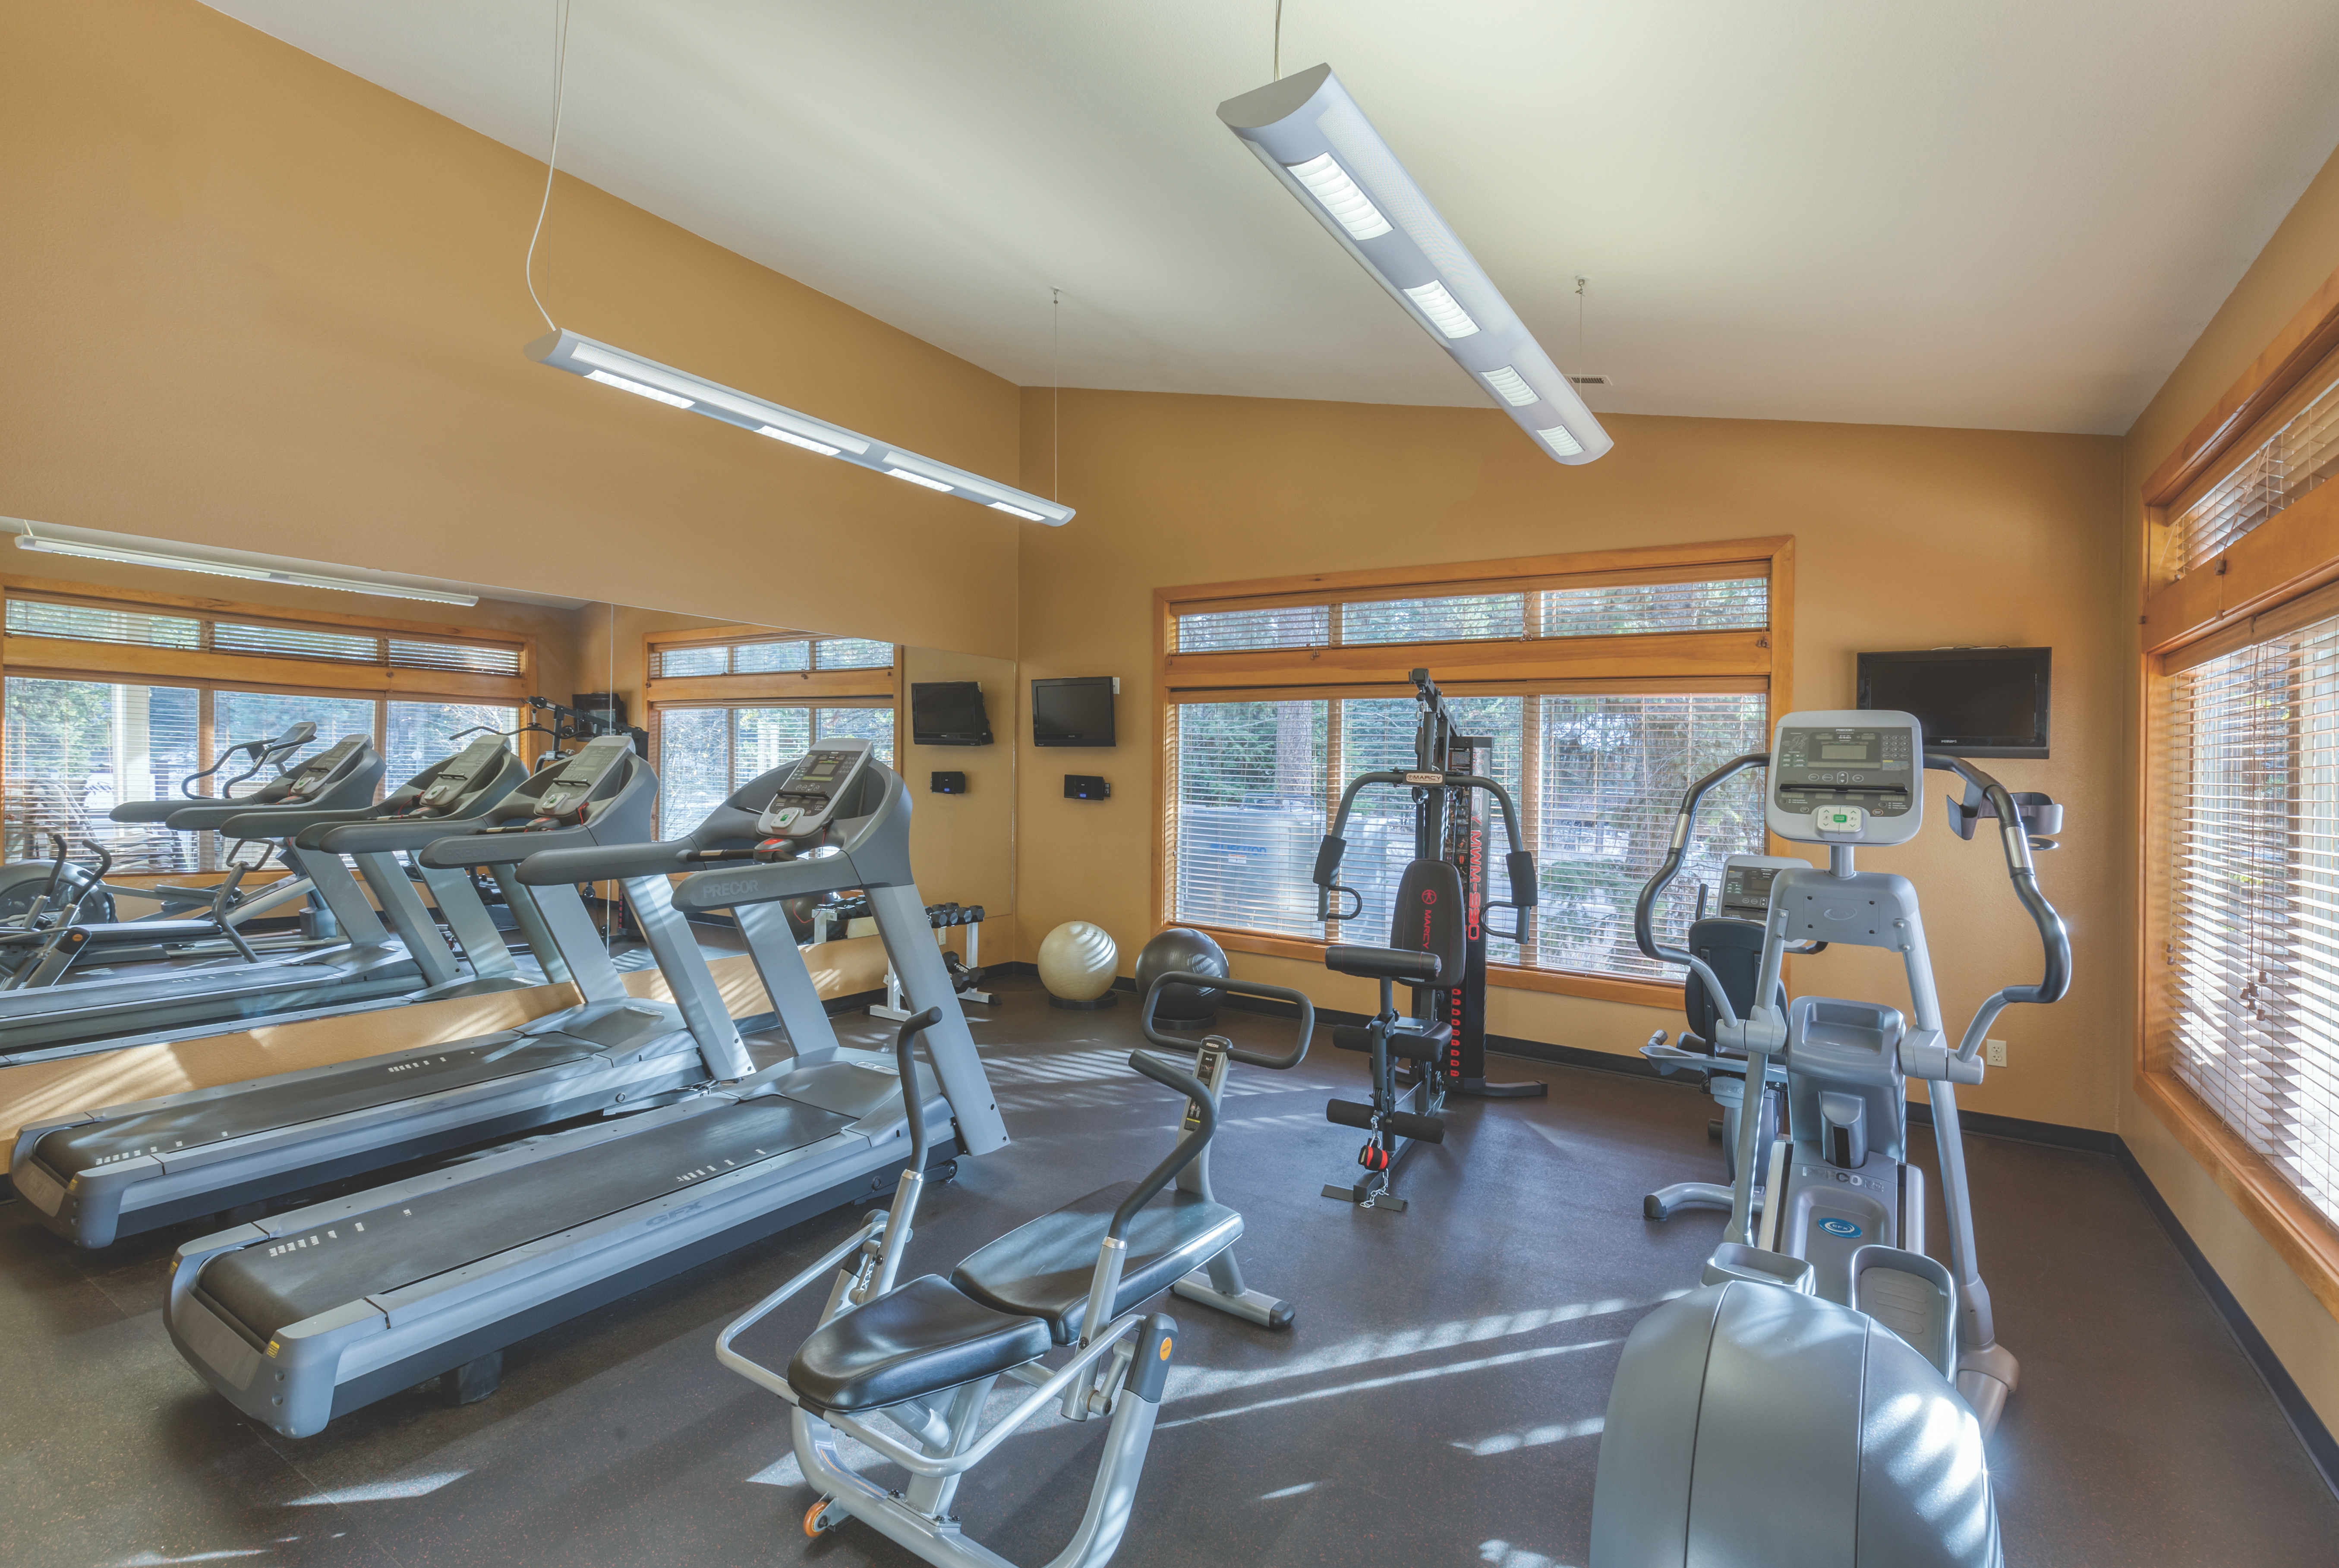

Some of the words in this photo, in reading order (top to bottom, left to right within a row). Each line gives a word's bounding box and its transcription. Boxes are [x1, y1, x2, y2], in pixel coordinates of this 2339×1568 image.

[703, 879, 759, 898] PRECOR
[1423, 910, 1431, 950] MARCY
[1803, 1166, 1874, 1190] PRECOR
[646, 1200, 704, 1226] GFX
